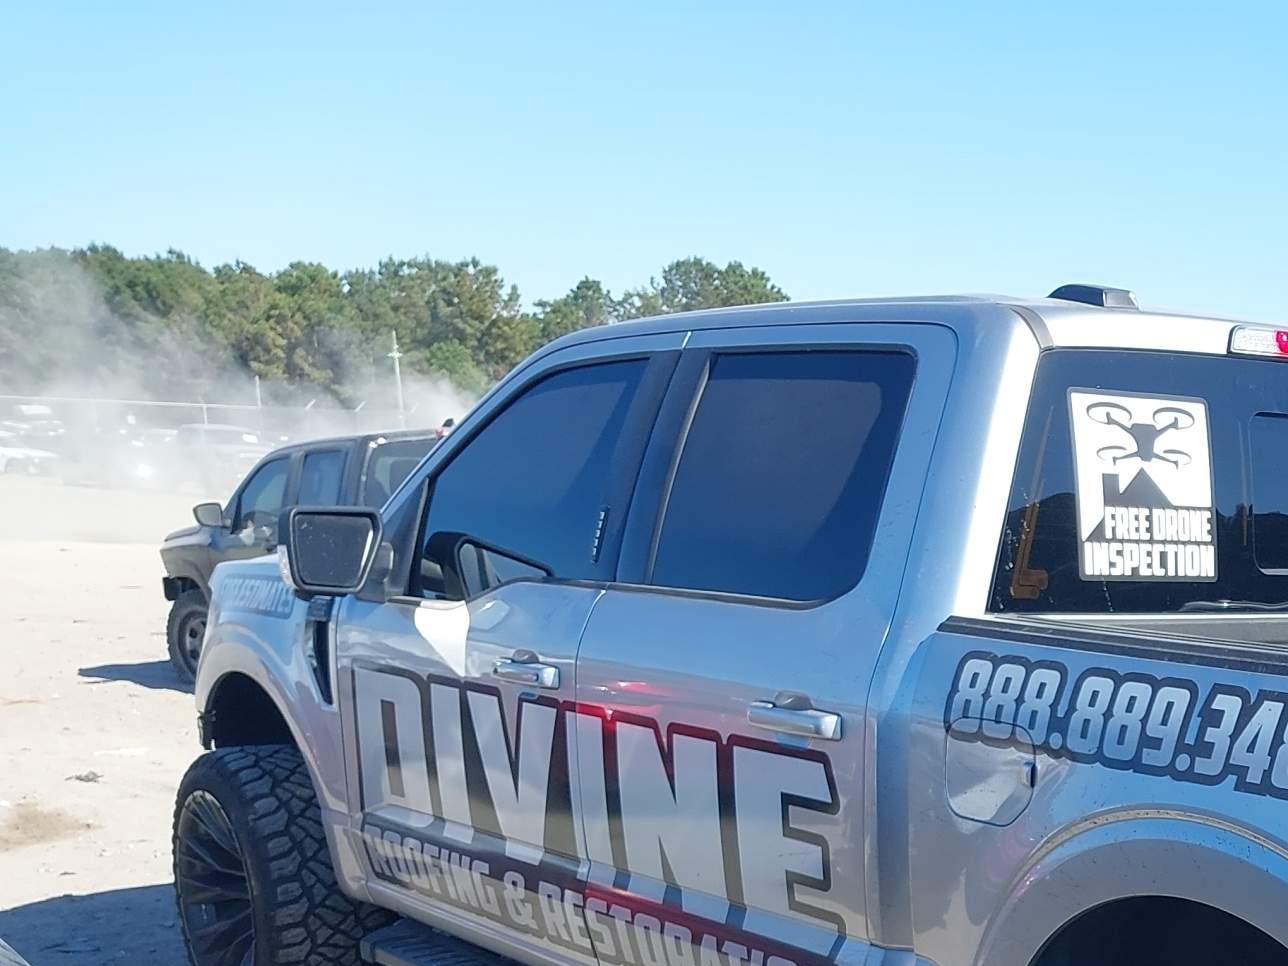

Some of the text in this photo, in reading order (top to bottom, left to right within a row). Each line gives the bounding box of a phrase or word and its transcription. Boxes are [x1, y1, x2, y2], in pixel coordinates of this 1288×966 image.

[1083, 541, 1215, 577] INSPECTION
[1104, 506, 1213, 542] FREE DRONE
[353, 664, 845, 962] DIVINE
[363, 823, 501, 915] ROOFING
[503, 870, 539, 930] &
